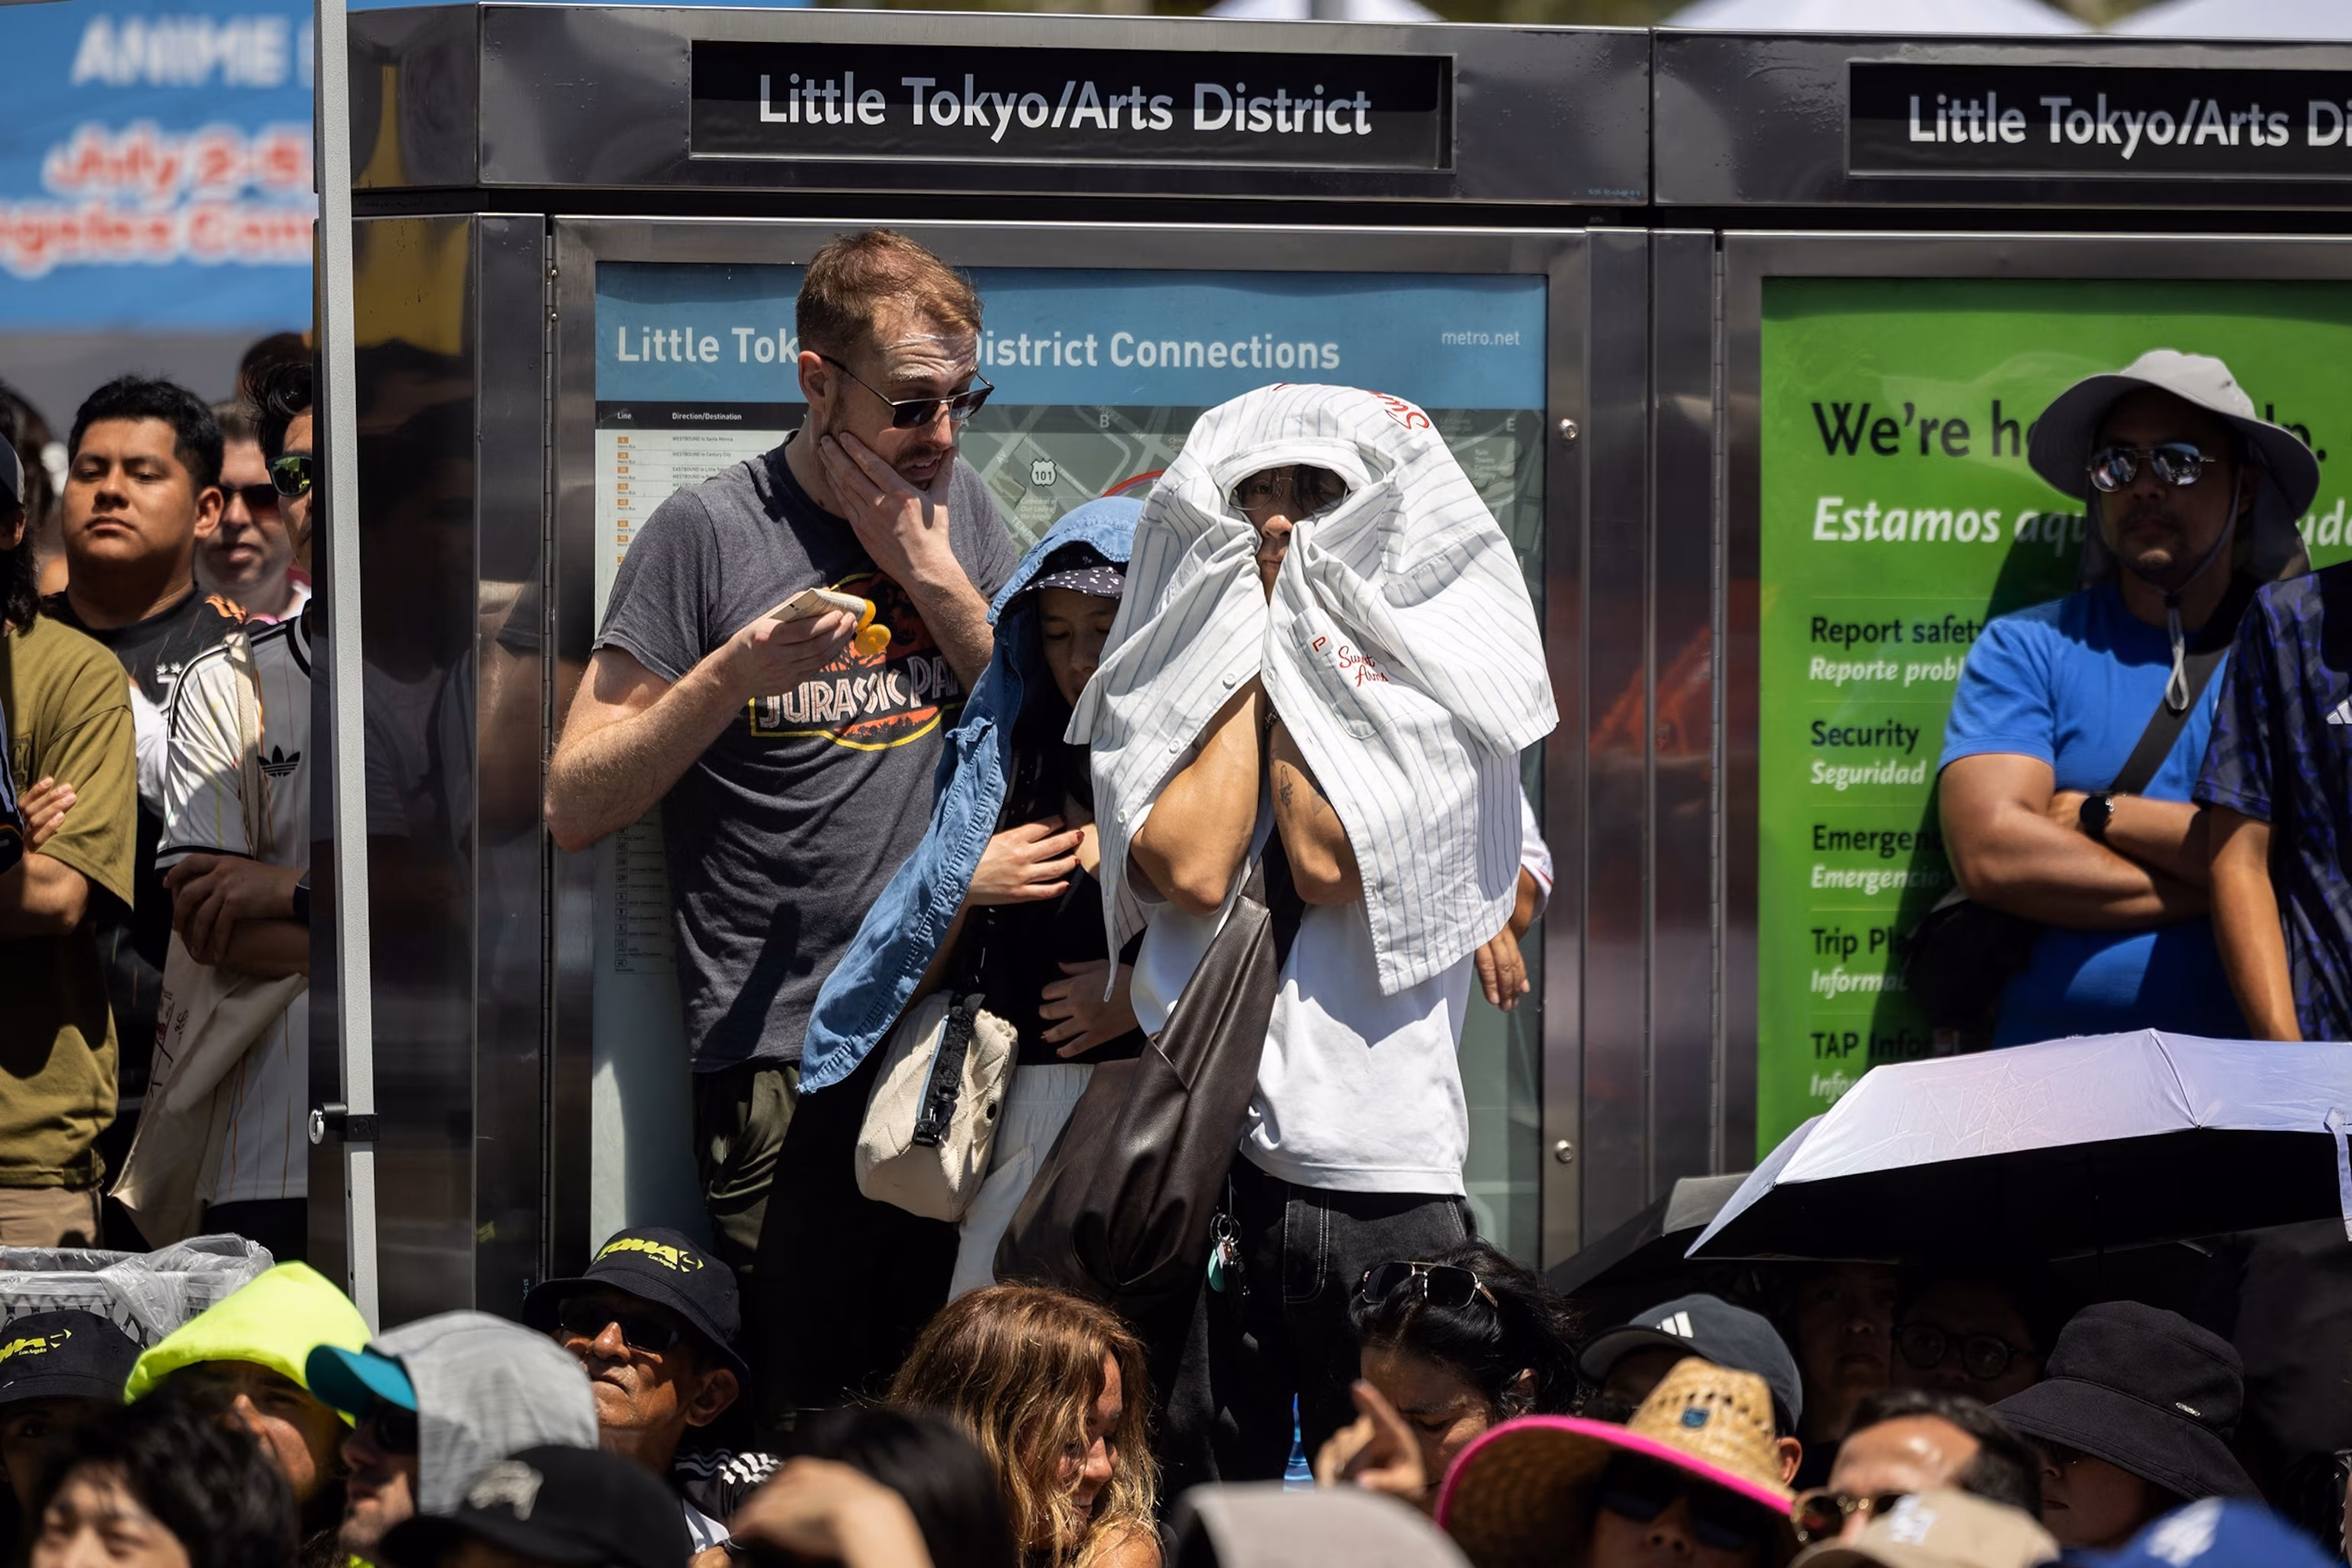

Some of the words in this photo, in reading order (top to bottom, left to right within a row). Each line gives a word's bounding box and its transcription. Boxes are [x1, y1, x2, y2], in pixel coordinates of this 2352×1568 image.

[760, 71, 887, 127] Little
[901, 74, 1175, 145] Tokyo/Arts
[1194, 82, 1373, 136] District
[1909, 90, 2027, 145] Little
[2040, 93, 2290, 161] Tokyo/Arts
[617, 326, 720, 364] Little
[731, 328, 798, 364] Tok
[1110, 332, 1341, 371] Connections
[1442, 331, 1521, 347] metro.net
[617, 412, 632, 420] Line
[671, 412, 743, 421] Direction/Destination
[1099, 414, 1110, 428] B
[1505, 417, 1516, 432] E
[1811, 402, 1971, 458] We're
[1034, 471, 1053, 481] 101
[1813, 496, 2002, 544] Estamos
[1811, 616, 1903, 652] Report
[1913, 615, 1983, 645] safet
[1810, 657, 1900, 688] Reporte
[759, 668, 906, 728] JURASSIC
[1810, 720, 1921, 756] Security
[1810, 760, 1926, 792] Seguridad
[1810, 927, 1859, 962] Trip
[1810, 1031, 1860, 1060] TAP
[648, 1253, 658, 1262] Los
